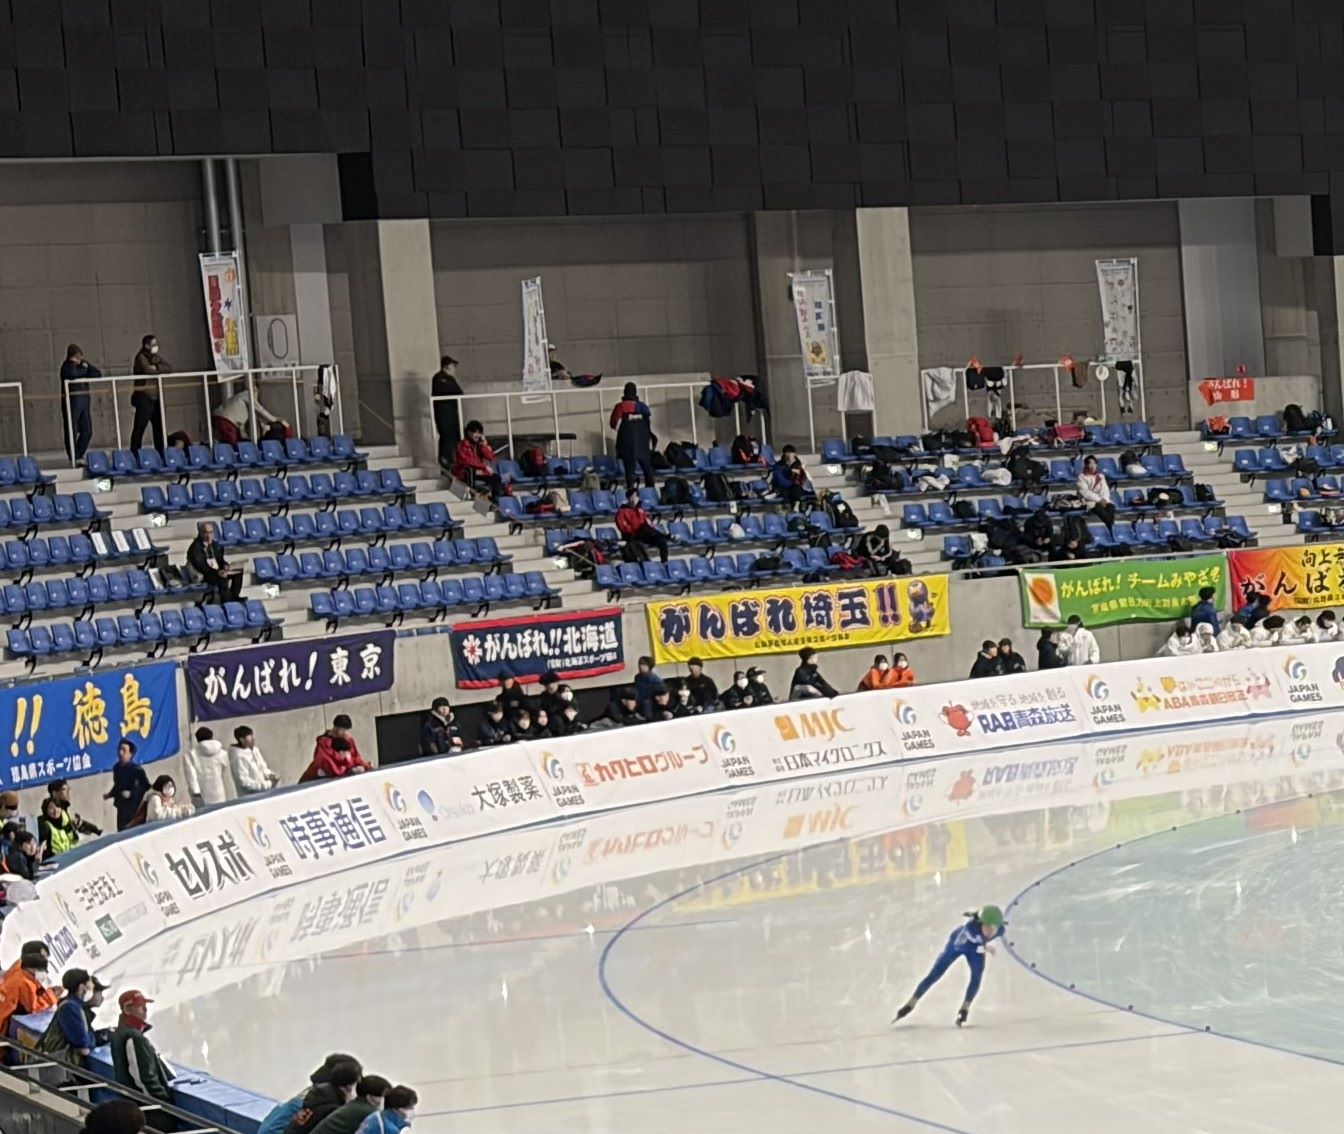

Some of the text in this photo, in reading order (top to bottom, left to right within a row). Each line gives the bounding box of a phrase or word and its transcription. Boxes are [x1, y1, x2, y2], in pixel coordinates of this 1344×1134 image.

[660, 582, 901, 646] がんばれ埼玉!!
[1288, 683, 1320, 694] JAPAN
[1290, 692, 1323, 703] GAMES
[73, 673, 153, 750] 徳島
[1090, 704, 1122, 715] JAPAN
[801, 708, 855, 741] MJC
[977, 703, 1076, 734] RAB青森放送
[1092, 713, 1126, 724] GAMES
[901, 730, 931, 741] JAPAN
[904, 739, 935, 750] GAMES
[721, 756, 751, 768] JAPAN
[784, 741, 886, 771] 日本マイクロニクス
[724, 767, 755, 778] GAMES
[471, 775, 543, 811] 大塚製薬
[552, 784, 580, 797] JAPAN
[556, 794, 585, 808] GAMES
[279, 797, 387, 860] 時事通信
[164, 829, 256, 898] セレスポ
